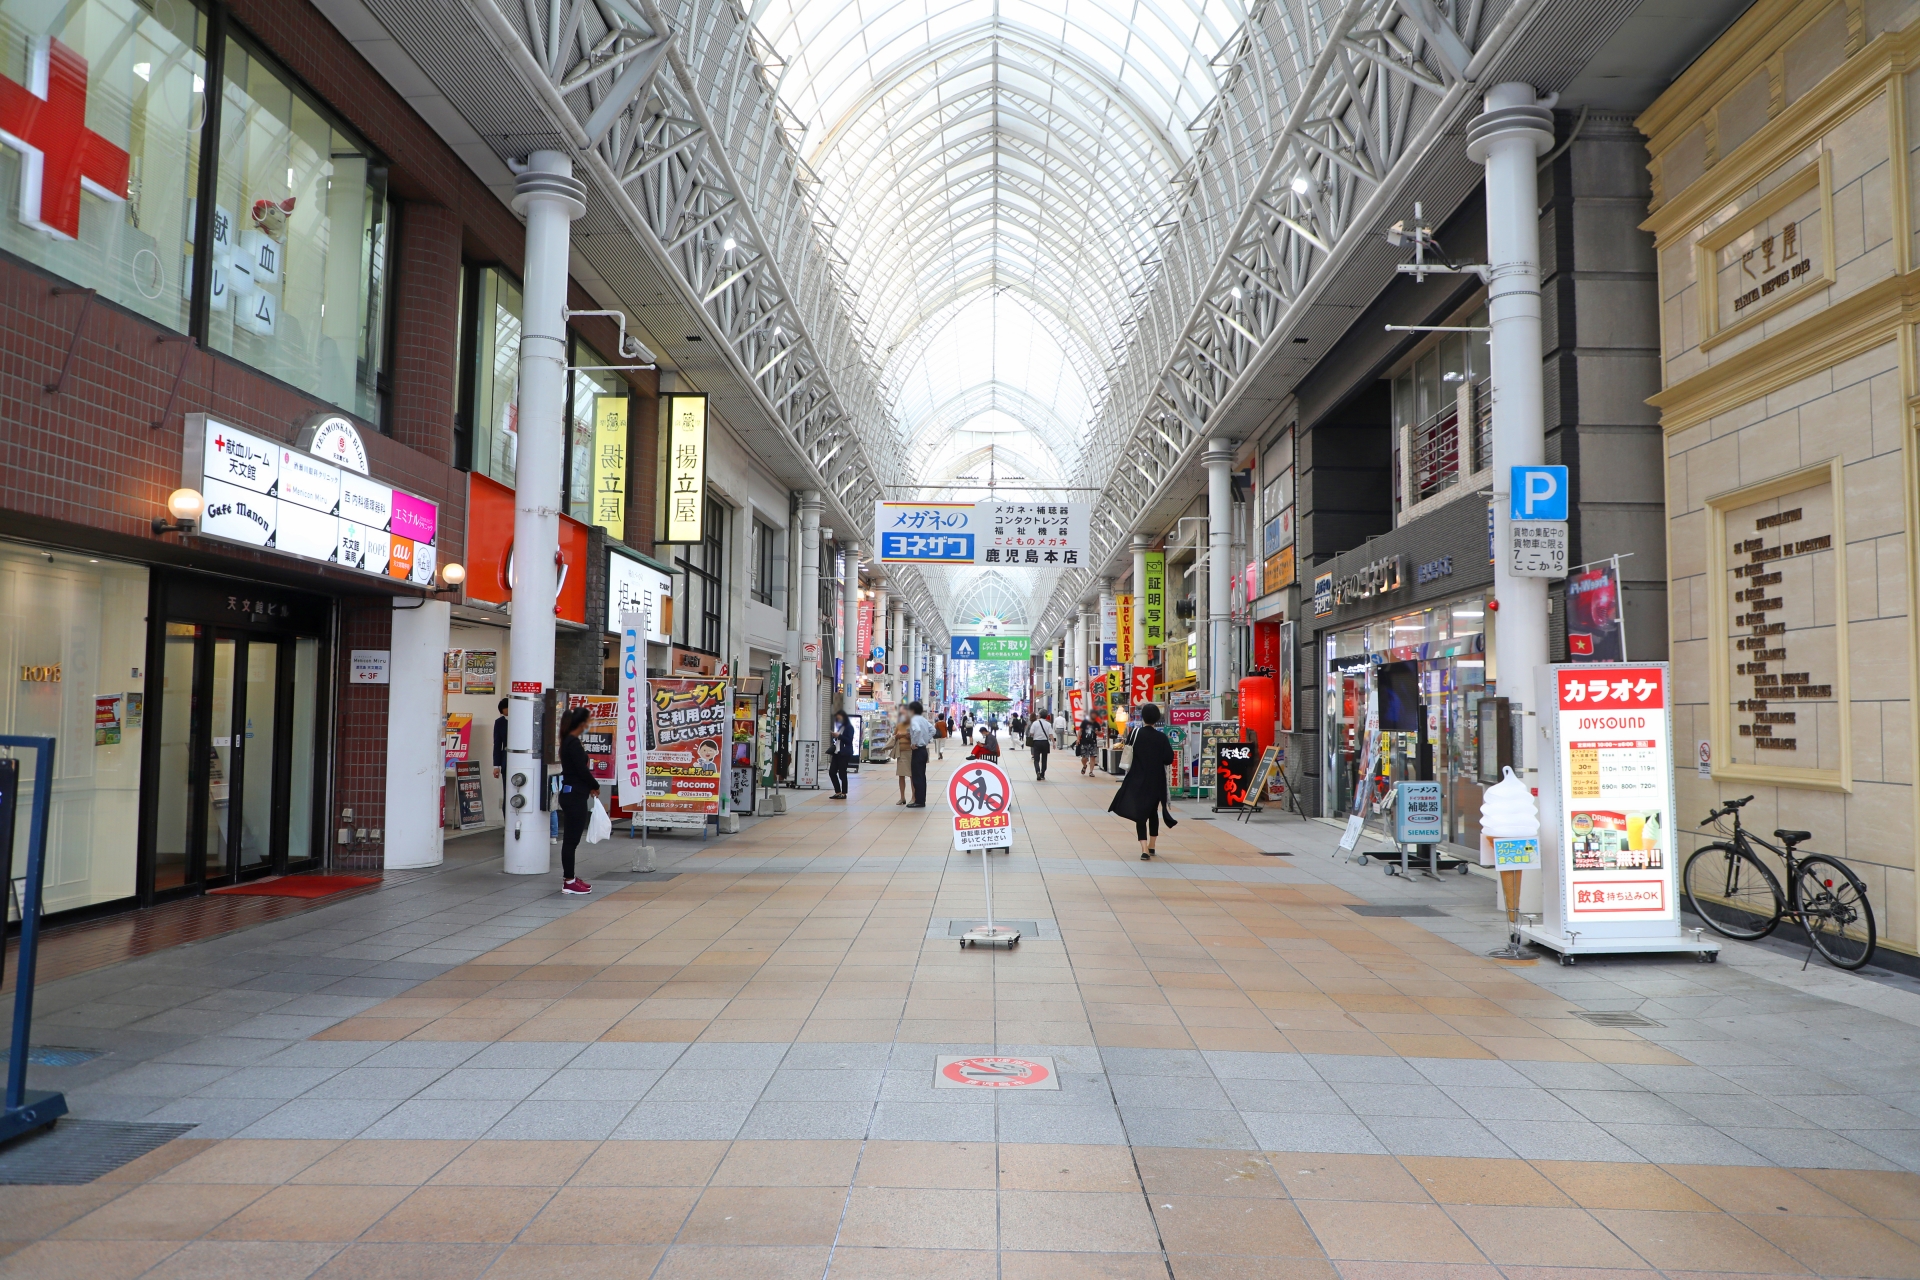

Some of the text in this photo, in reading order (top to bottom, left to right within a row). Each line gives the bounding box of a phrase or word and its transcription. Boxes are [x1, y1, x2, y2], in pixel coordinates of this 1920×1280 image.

[1761, 270, 1790, 297] DEPUIS
[1791, 258, 1811, 280] 1912
[315, 422, 353, 450] TENMONKAN
[225, 438, 270, 467] 献血ルーム
[228, 457, 257, 481] 天文館
[673, 443, 699, 523] 揚立屋
[1525, 471, 1558, 515] P
[207, 502, 270, 532] Café Manon
[395, 508, 419, 526] エミナル
[994, 505, 1069, 515] メガネ・補聴器
[890, 510, 969, 531] メガネの
[994, 516, 1069, 526] コンタクトレンズ
[1755, 507, 1803, 531] INFORMATION
[994, 526, 1068, 536] 福祉機器
[1513, 527, 1564, 538] 貨物の集配中の
[342, 536, 360, 552] 天文館
[888, 535, 968, 557] ヨネザワ
[994, 536, 1068, 546] こどものメガネ
[1513, 538, 1564, 549] 貨物車に限る
[1783, 534, 1831, 557] DE LOCATION
[367, 541, 388, 558] ROPÉ
[393, 543, 411, 561] au
[985, 548, 1079, 564] 鹿児島本店
[1513, 550, 1565, 561] 7 10
[1513, 561, 1564, 572] ここから
[226, 596, 290, 618] 天文館ビル
[1147, 576, 1162, 638] 証明写真
[1753, 622, 1786, 637] KARAOKE
[996, 640, 1028, 652] 下取り
[1753, 648, 1787, 662] KARAOKE
[467, 659, 485, 668] SIM
[20, 663, 62, 683] ROPÉ
[367, 672, 379, 680] 3F
[655, 680, 727, 710] ケータイ
[1563, 678, 1658, 703] カラオケ
[1754, 686, 1796, 699] PHARMACIE
[658, 704, 725, 727] ご利用の方
[1755, 712, 1796, 724] PHARMACIE
[1578, 716, 1646, 730] JOYSOUND
[451, 736, 460, 750] 7
[1755, 738, 1797, 751] PHARMACIE
[676, 780, 716, 789] docomo
[1407, 786, 1439, 794] シーメンス
[1407, 801, 1439, 813] 補聴器
[958, 815, 1006, 829] 危険です!
[1591, 813, 1626, 826] DRINK BAR
[960, 827, 1006, 838] 自転車は押して
[961, 835, 1007, 845] 歩いてください
[1497, 848, 1523, 856] クリーム
[1577, 889, 1659, 904] 飲食 持ち込みOK
